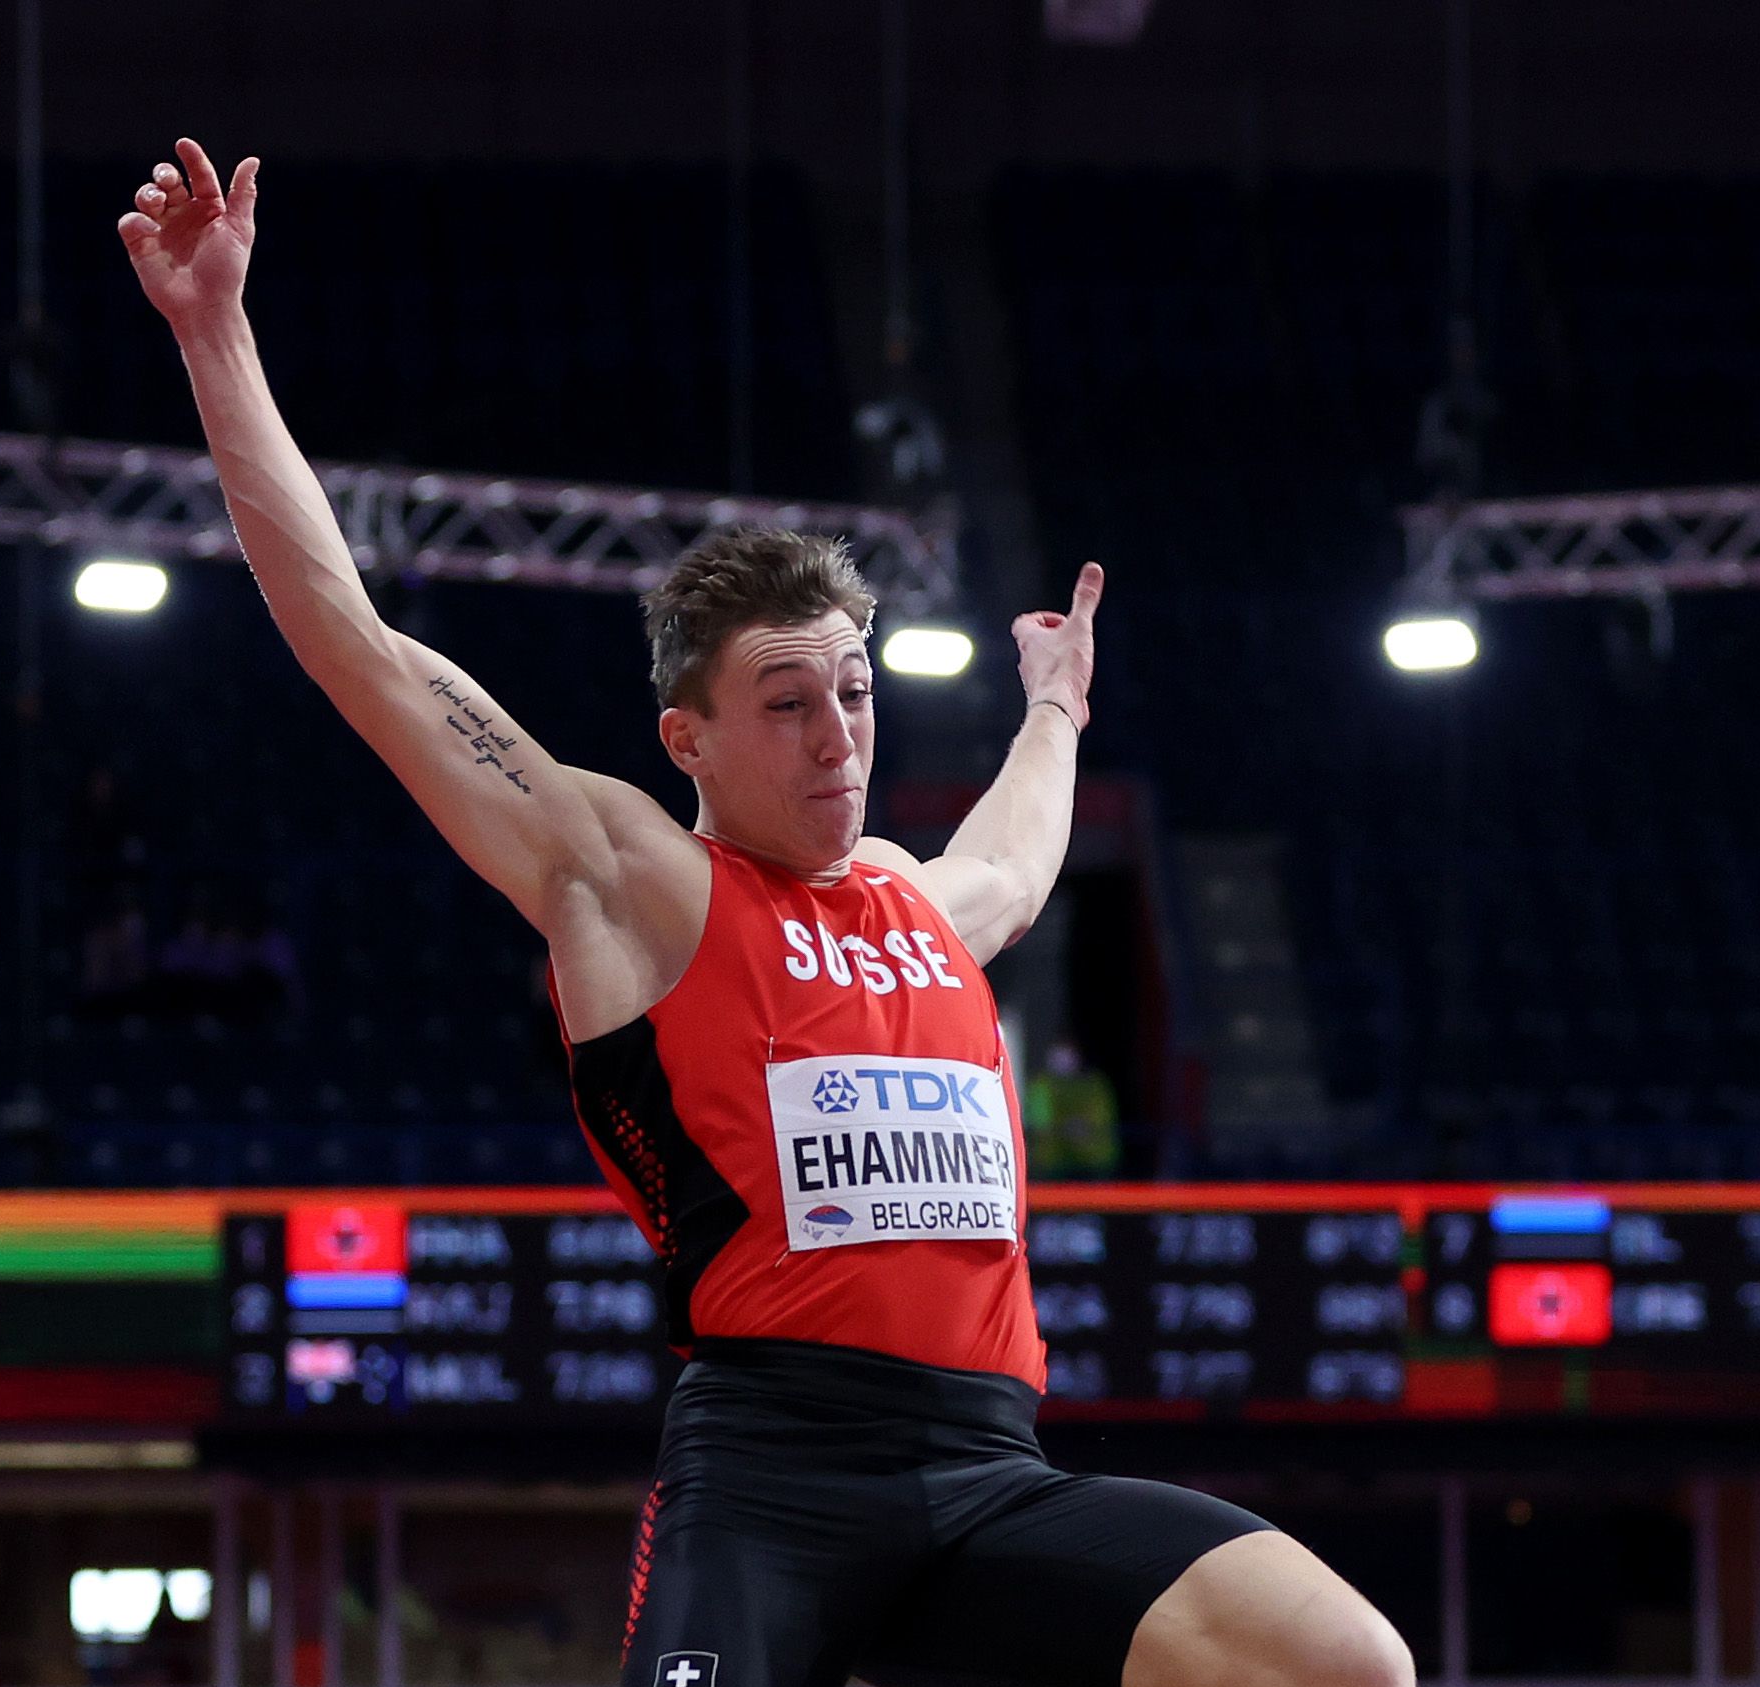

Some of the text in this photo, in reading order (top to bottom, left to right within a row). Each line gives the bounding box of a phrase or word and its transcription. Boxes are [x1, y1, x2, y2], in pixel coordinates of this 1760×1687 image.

[428, 676, 470, 706] Hard
[855, 1069, 989, 1118] TDK
[793, 1131, 1013, 1193] EHAMMER
[872, 1202, 1005, 1231] BELGRADE
